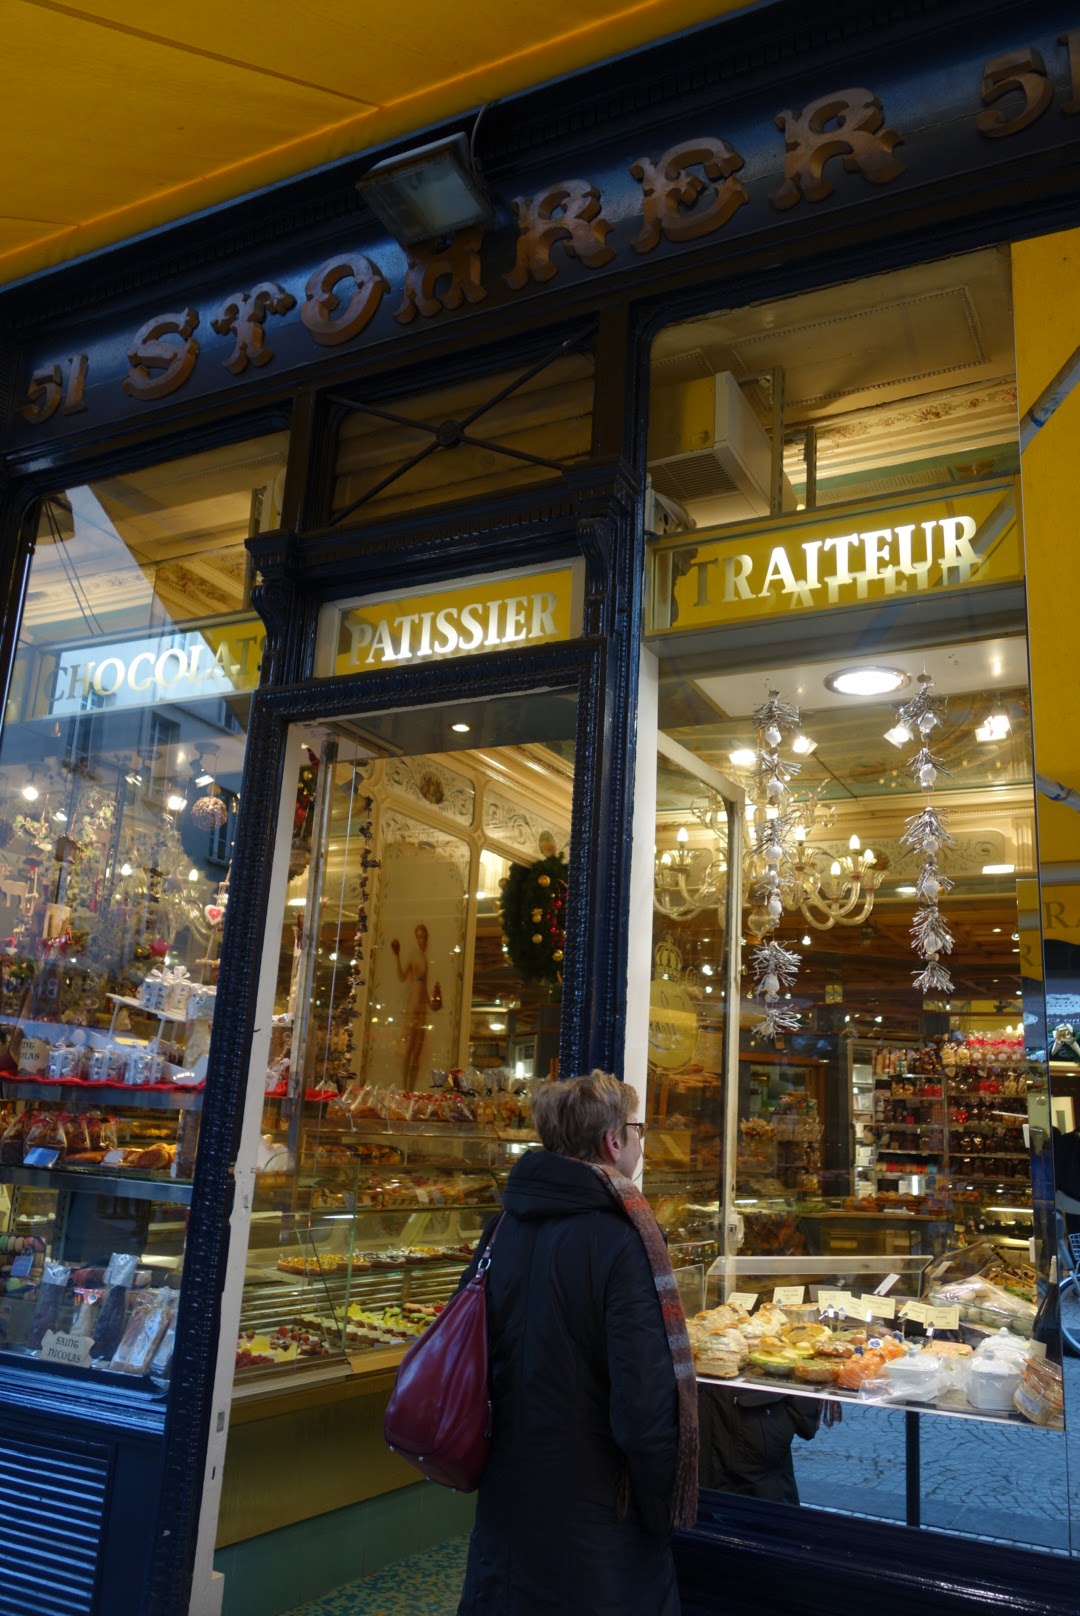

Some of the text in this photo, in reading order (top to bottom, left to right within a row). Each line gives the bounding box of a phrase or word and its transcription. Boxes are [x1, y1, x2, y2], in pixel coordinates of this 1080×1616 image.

[22, 353, 89, 425] 51
[123, 87, 908, 401] STOHRER
[691, 514, 981, 607] TRAITEUR
[348, 590, 560, 667] PATISSIER
[48, 1348, 82, 1363] NICOLAS
